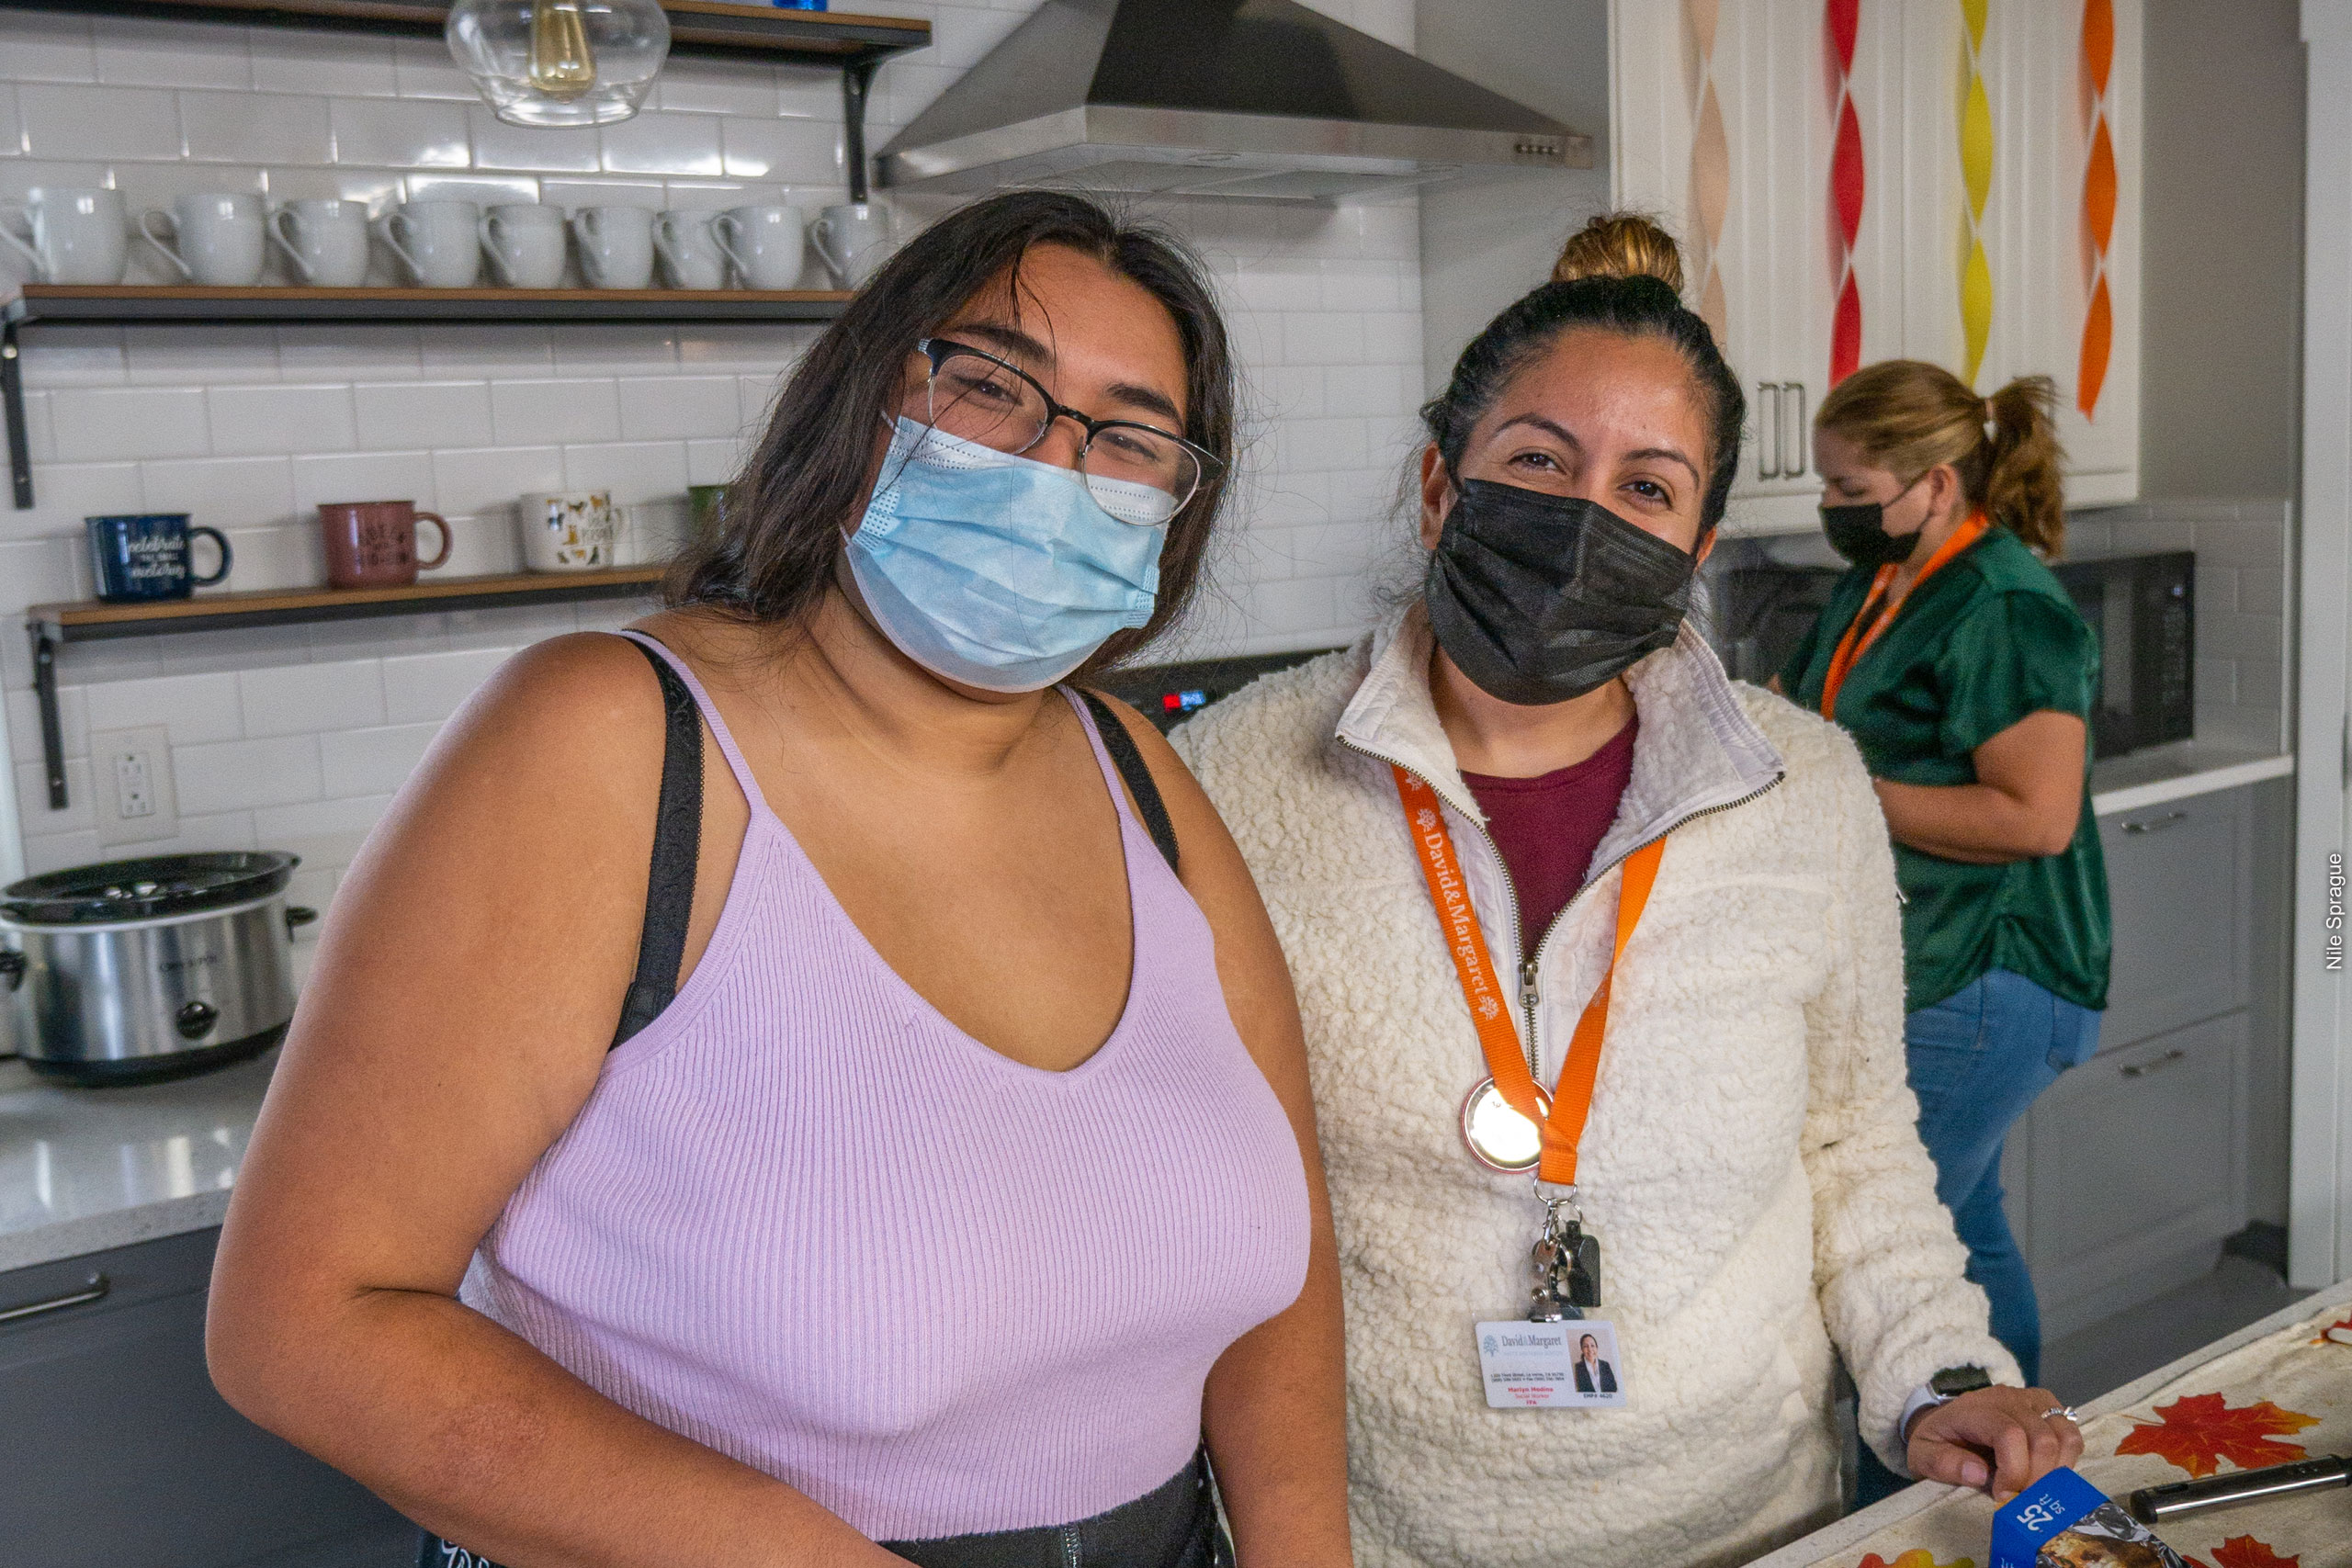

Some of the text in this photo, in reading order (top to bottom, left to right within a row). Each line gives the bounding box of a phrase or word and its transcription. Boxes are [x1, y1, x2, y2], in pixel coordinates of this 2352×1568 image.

[1423, 831, 1489, 997] David&Margaret
[2016, 1503, 2054, 1532] 25
[2038, 1493, 2065, 1515] sq ft
